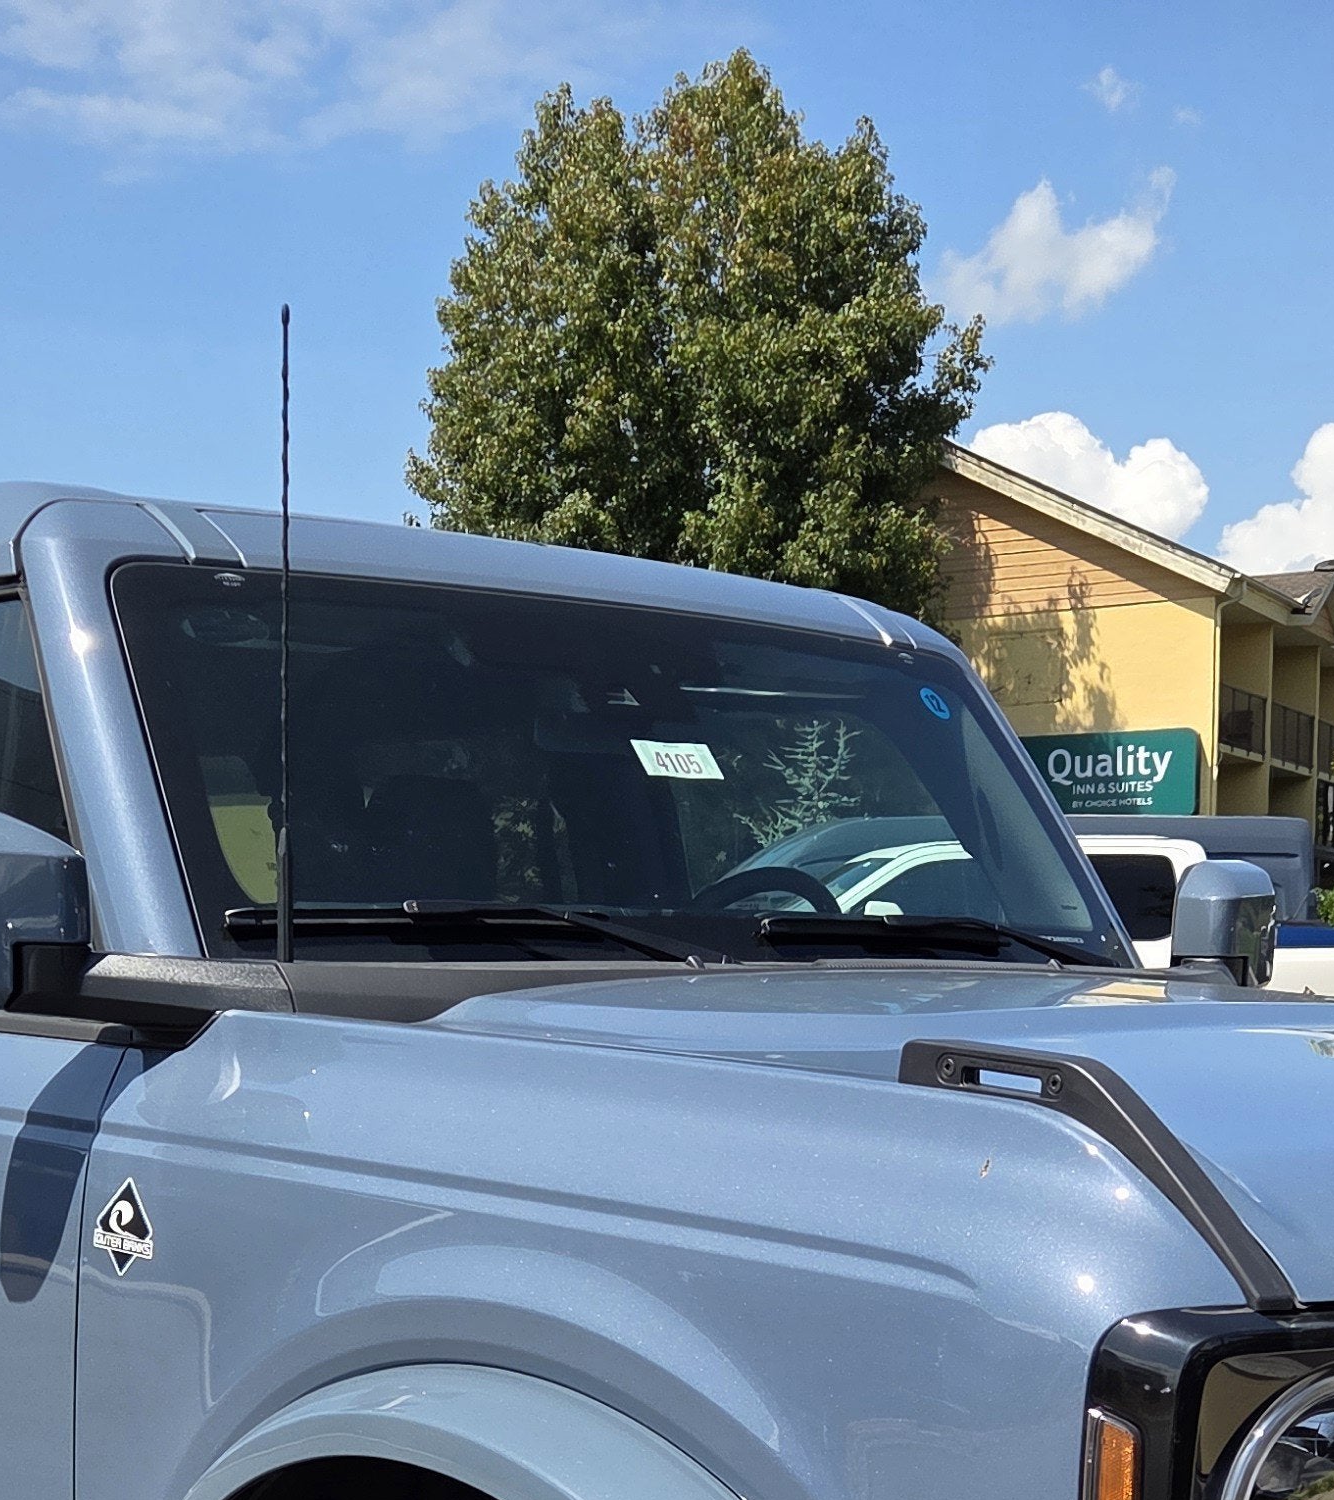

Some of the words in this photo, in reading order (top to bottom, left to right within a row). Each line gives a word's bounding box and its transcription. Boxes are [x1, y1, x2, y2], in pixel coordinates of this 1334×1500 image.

[654, 751, 703, 774] 4105
[1047, 744, 1173, 785] Quality
[1072, 783, 1095, 795] INN
[1097, 784, 1106, 794] &
[1107, 780, 1154, 794] SUITES
[1071, 800, 1083, 809] BY
[1085, 799, 1117, 808] CHOICE
[1119, 797, 1153, 806] HOTELS
